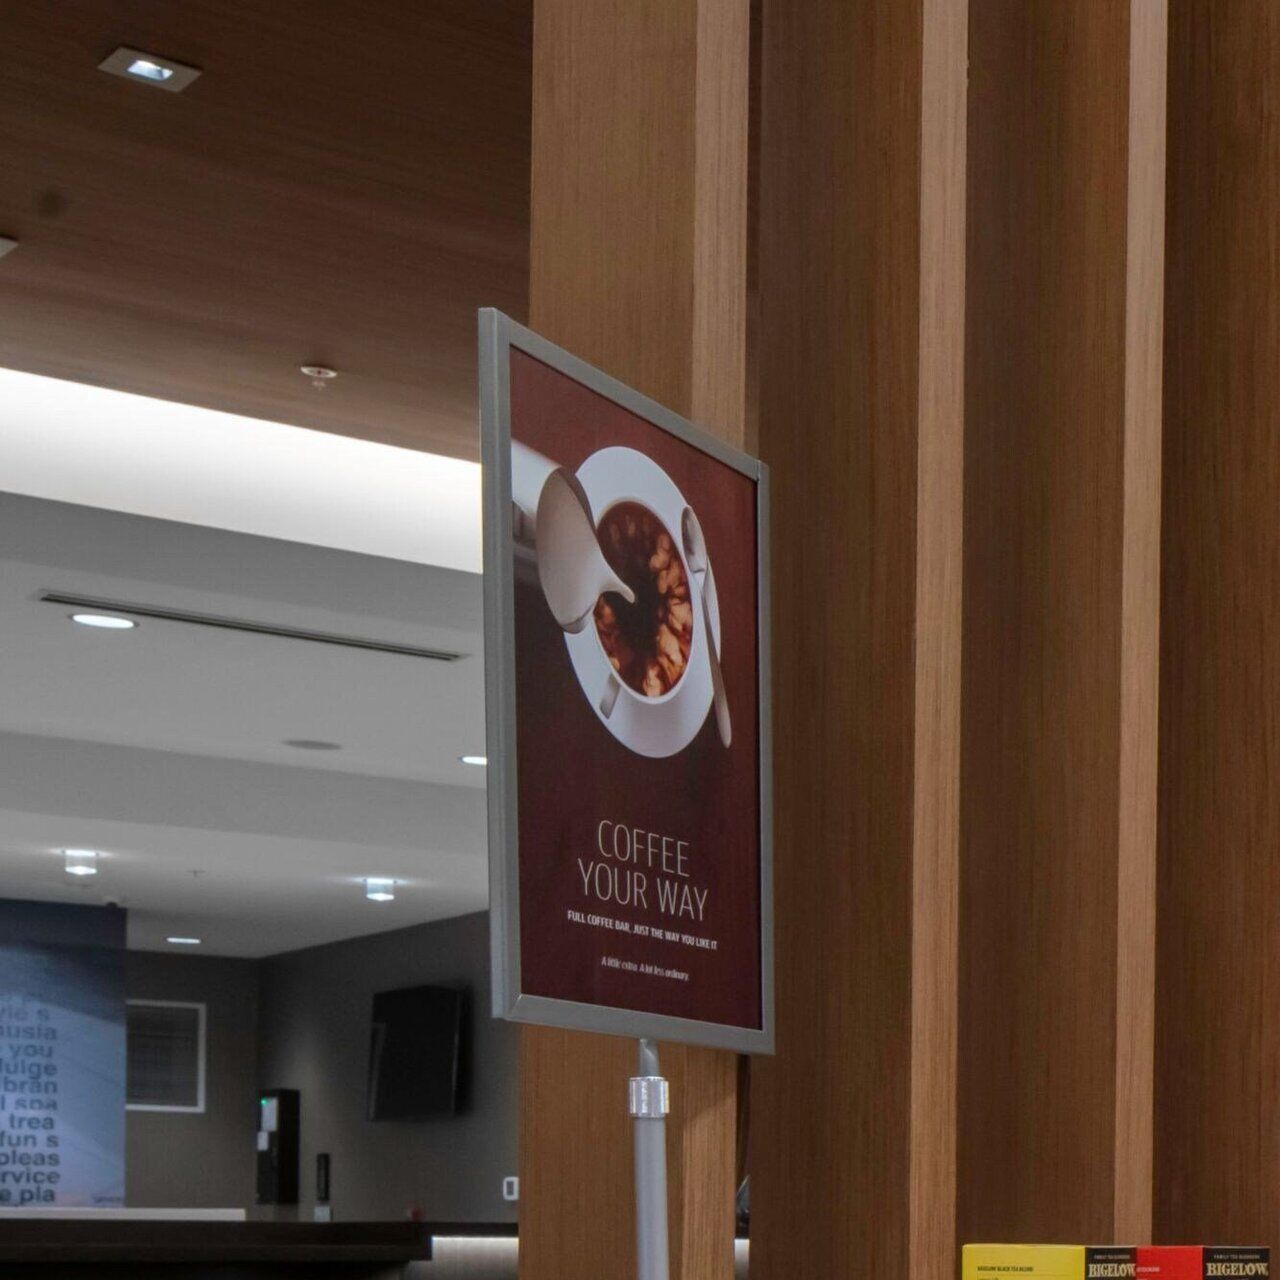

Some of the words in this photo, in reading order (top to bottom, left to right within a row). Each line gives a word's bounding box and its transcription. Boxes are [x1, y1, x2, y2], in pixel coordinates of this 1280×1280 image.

[598, 820, 690, 877] COFFEE
[577, 858, 647, 909] YOUR
[657, 878, 708, 921] WAY
[567, 910, 585, 924] FULL
[587, 914, 614, 930] COFFEE
[633, 924, 649, 937] JUST
[651, 927, 664, 939] THE
[665, 931, 680, 943] WAY
[681, 934, 695, 946] YOU
[696, 938, 710, 950] LIKE
[711, 941, 718, 950] IT
[9, 1044, 53, 1059] you
[0, 1058, 58, 1079] ulge
[4, 1076, 58, 1094] bran
[9, 1113, 54, 1130] trea
[0, 1131, 36, 1148] fun
[1088, 1263, 1136, 1277] BIGELOW
[1206, 1263, 1268, 1276] BIGELOW
